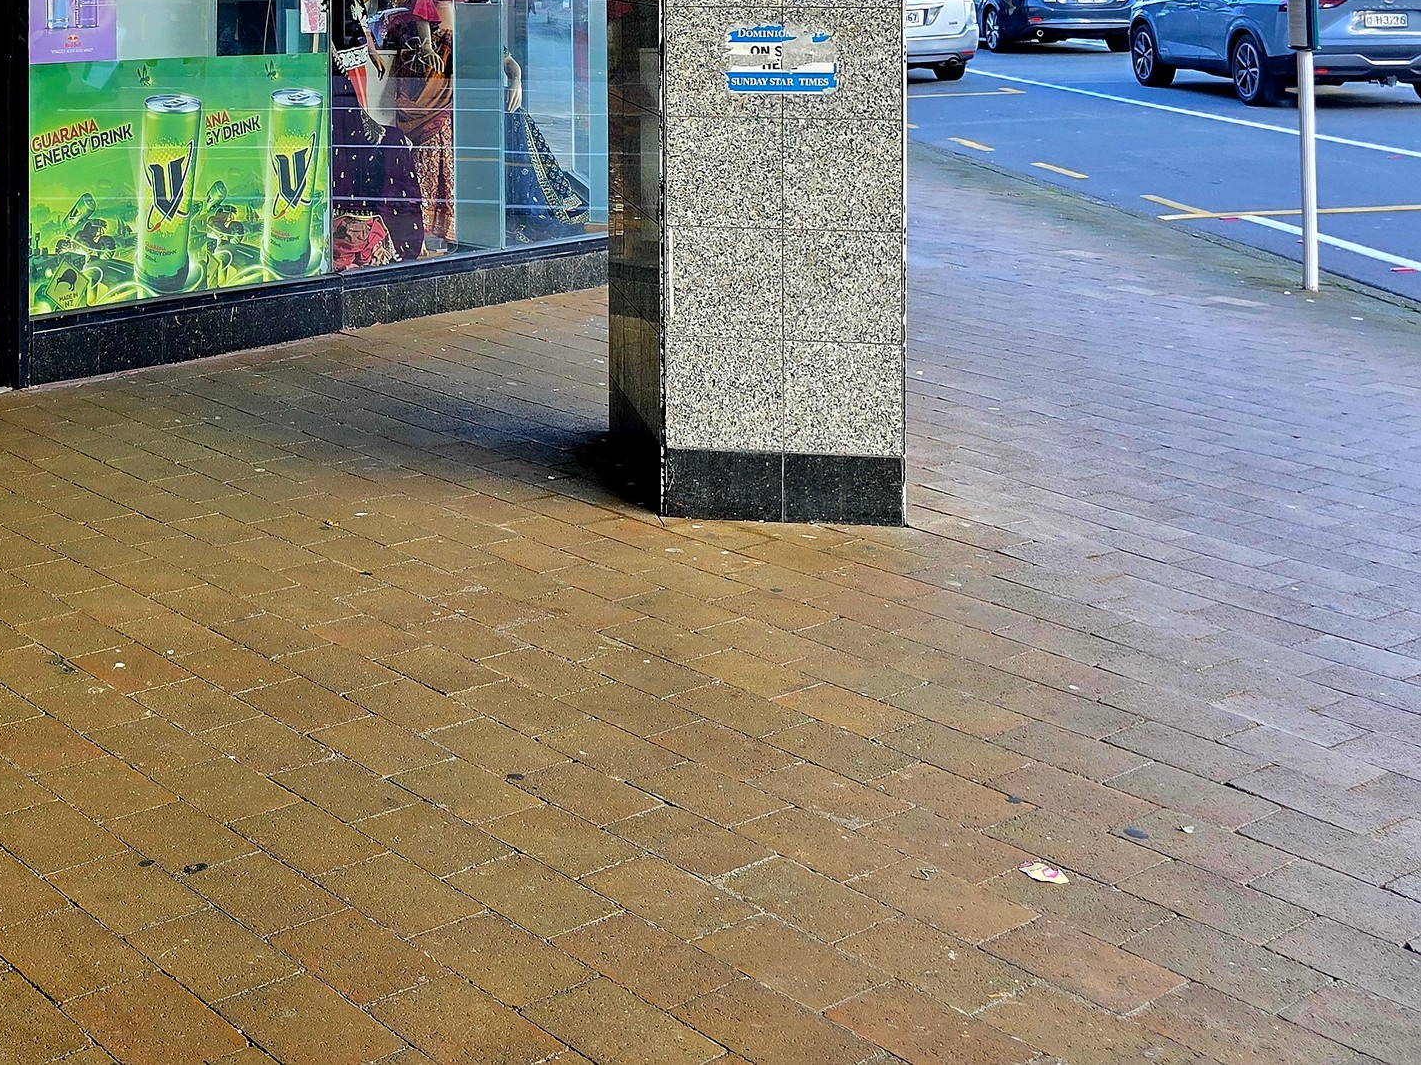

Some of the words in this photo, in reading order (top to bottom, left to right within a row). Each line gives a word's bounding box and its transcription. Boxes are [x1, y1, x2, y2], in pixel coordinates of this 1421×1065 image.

[736, 29, 790, 38] DOMINIO
[750, 46, 770, 54] ON
[731, 78, 768, 86] SUNDAY
[770, 78, 794, 86] STAR
[798, 78, 830, 86] TIMES
[32, 118, 98, 152] GUARANA
[223, 116, 262, 143] DRINK
[34, 138, 89, 170] ENERGY
[90, 124, 133, 150] DRINK
